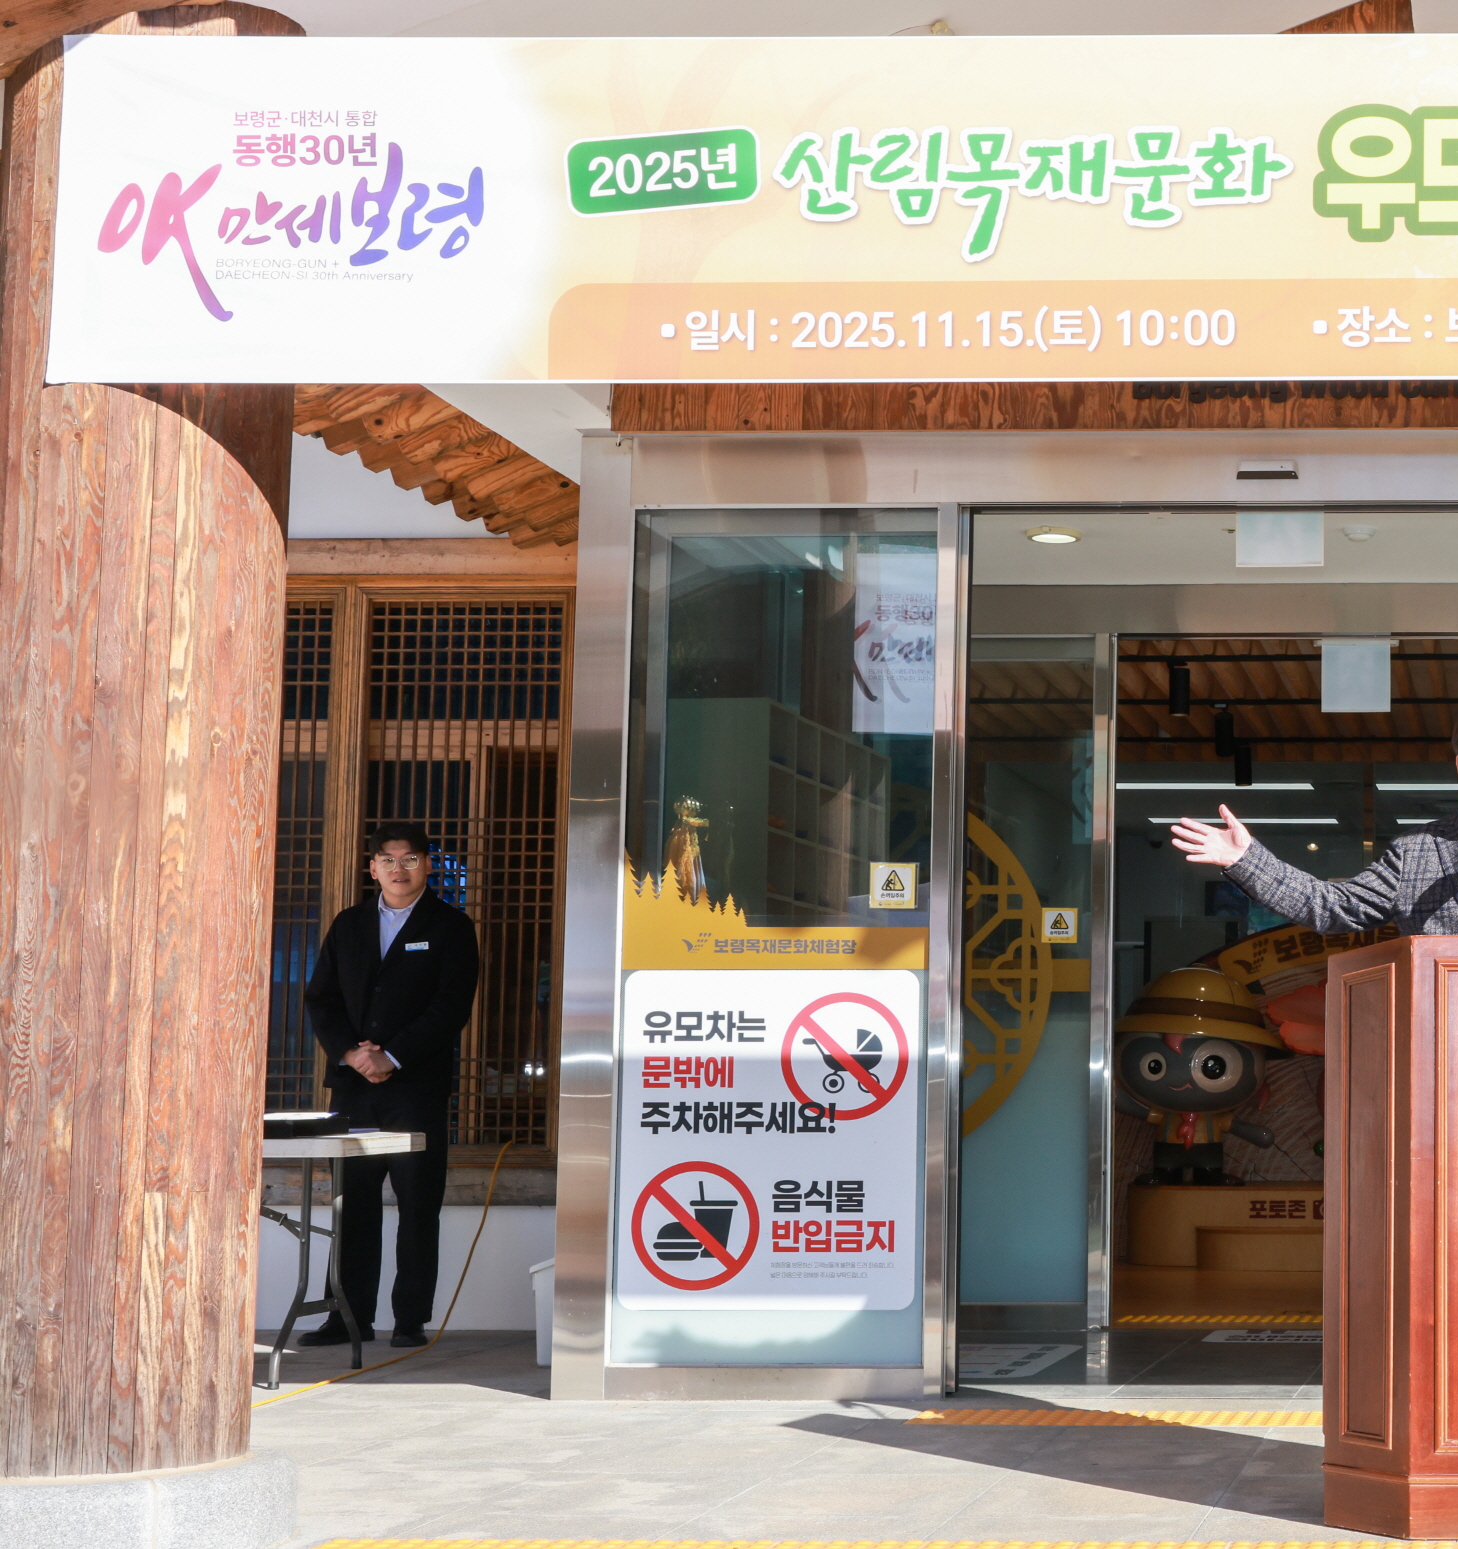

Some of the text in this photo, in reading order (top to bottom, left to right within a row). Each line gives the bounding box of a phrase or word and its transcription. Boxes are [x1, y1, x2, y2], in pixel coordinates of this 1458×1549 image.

[233, 110, 378, 128] 보령군·대천시 통합
[232, 133, 378, 168] 동행30년
[587, 141, 739, 198] 2025년
[779, 131, 1287, 258] 산림목재문화
[97, 163, 233, 322] OK
[215, 258, 328, 269] BORYEONG-GUN
[215, 270, 414, 283] DAECHEON-SI 30th Anniversary
[685, 308, 757, 351] 일시
[790, 305, 1102, 352] 2025.11.15.(토)
[1115, 309, 1237, 350] 10:00
[1337, 305, 1412, 348] 장소
[713, 938, 857, 955] 보령목재문화체험장
[642, 1010, 766, 1043] 유모차는
[641, 1055, 734, 1089] 문밖에
[640, 1101, 837, 1135] 주차해주세요!
[771, 1179, 866, 1214] 음식물
[1249, 1200, 1306, 1219] 포토존
[771, 1219, 895, 1253] 반입금지
